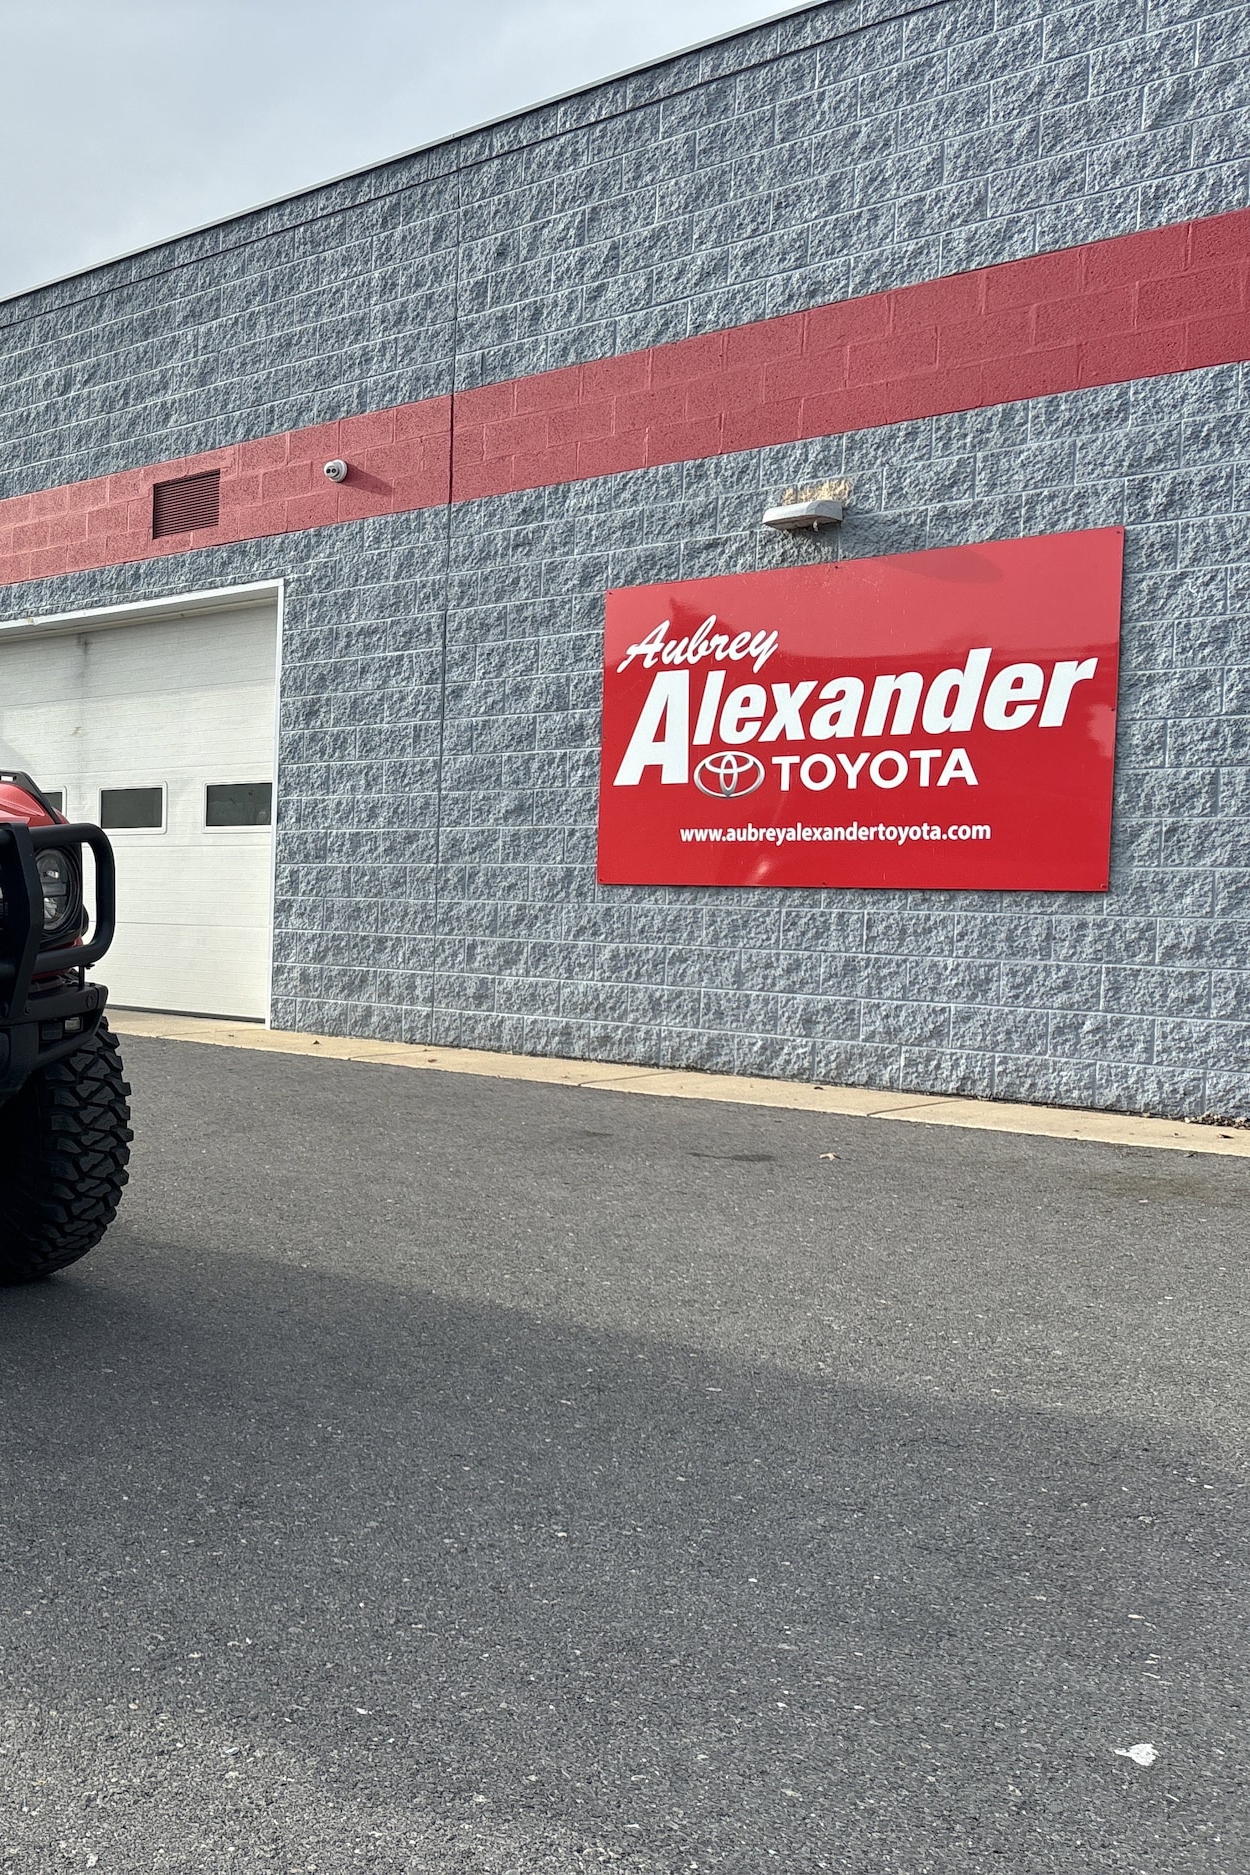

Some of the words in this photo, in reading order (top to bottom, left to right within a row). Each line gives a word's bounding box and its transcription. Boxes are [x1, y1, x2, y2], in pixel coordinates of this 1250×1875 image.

[616, 614, 779, 673] Aubrey
[613, 647, 1098, 786] Alexander
[771, 748, 979, 792] TOYOTA
[679, 821, 992, 846] www.aubreyalexandertoyota.com
